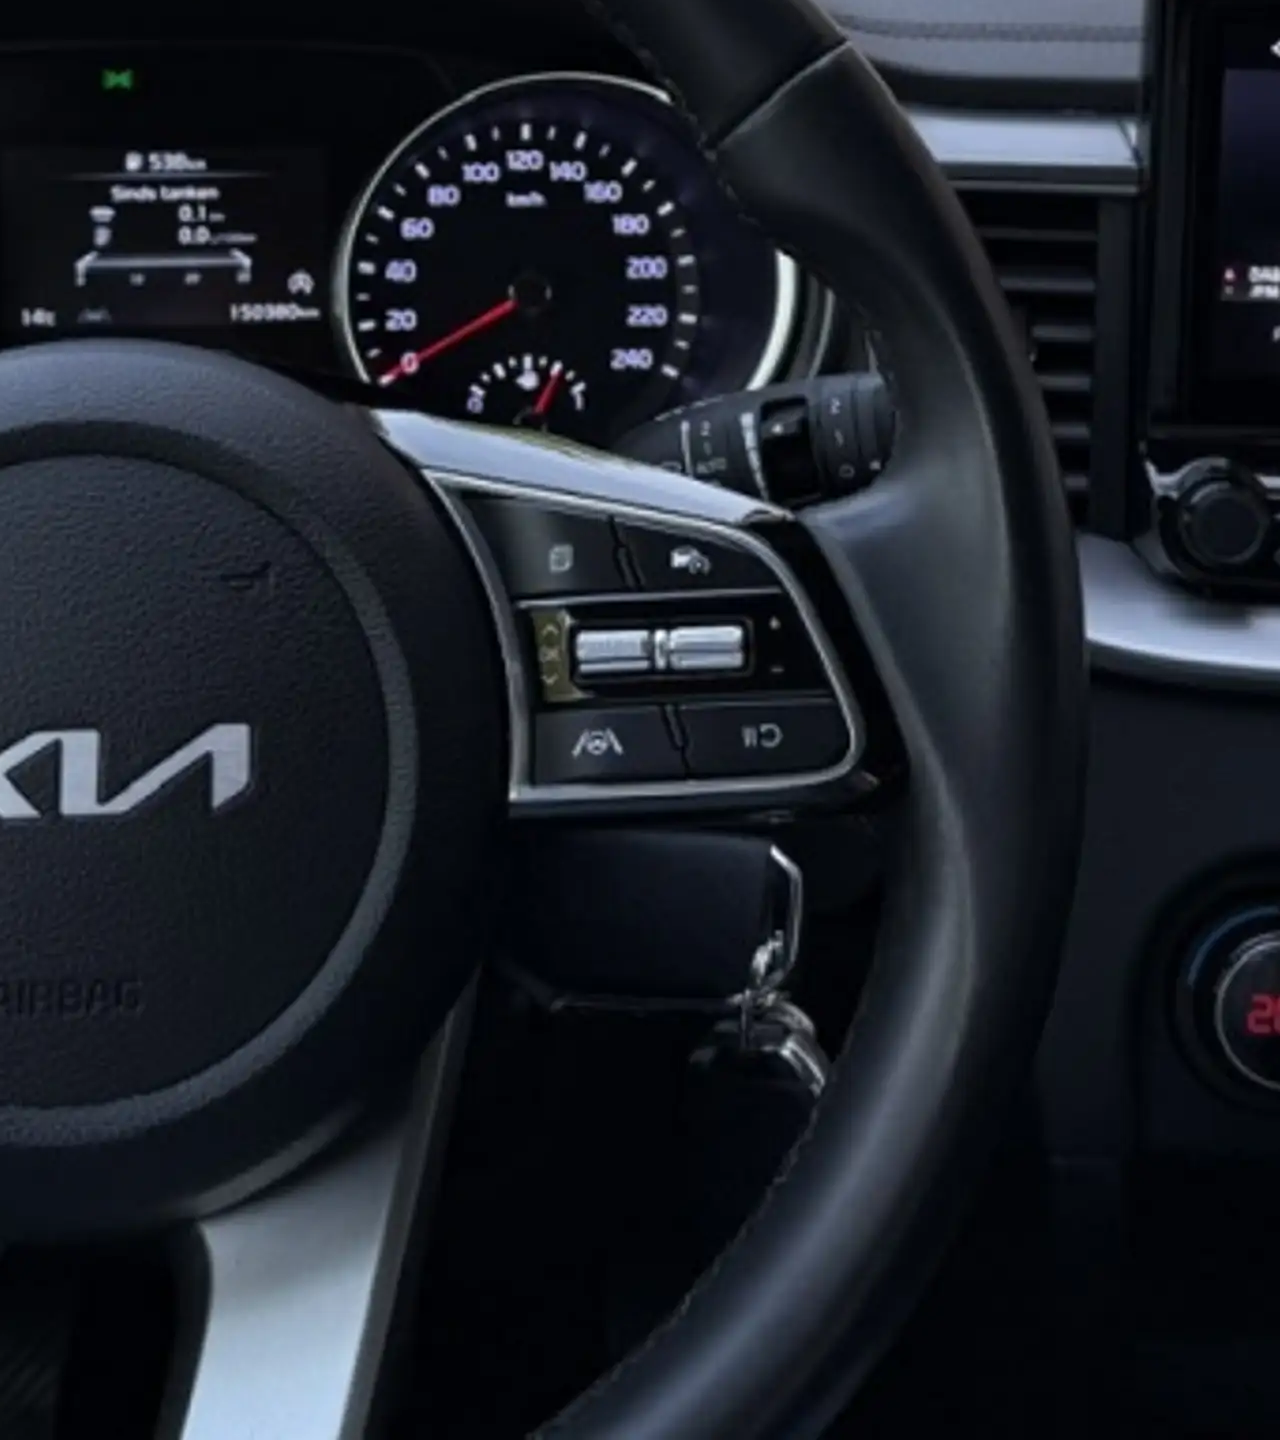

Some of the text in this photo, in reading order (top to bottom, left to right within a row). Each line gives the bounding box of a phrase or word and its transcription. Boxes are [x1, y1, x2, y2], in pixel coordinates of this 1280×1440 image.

[505, 149, 544, 171] 120
[462, 162, 500, 182] 100
[549, 161, 587, 182] 140
[426, 184, 461, 206] 80
[584, 180, 622, 203] 160
[400, 216, 434, 240] 60
[612, 213, 650, 235] 180
[385, 259, 417, 282] 40
[625, 255, 668, 280] 200
[385, 309, 417, 331] 20
[625, 304, 668, 328] 220
[400, 352, 419, 373] 0
[610, 348, 653, 371] 240
